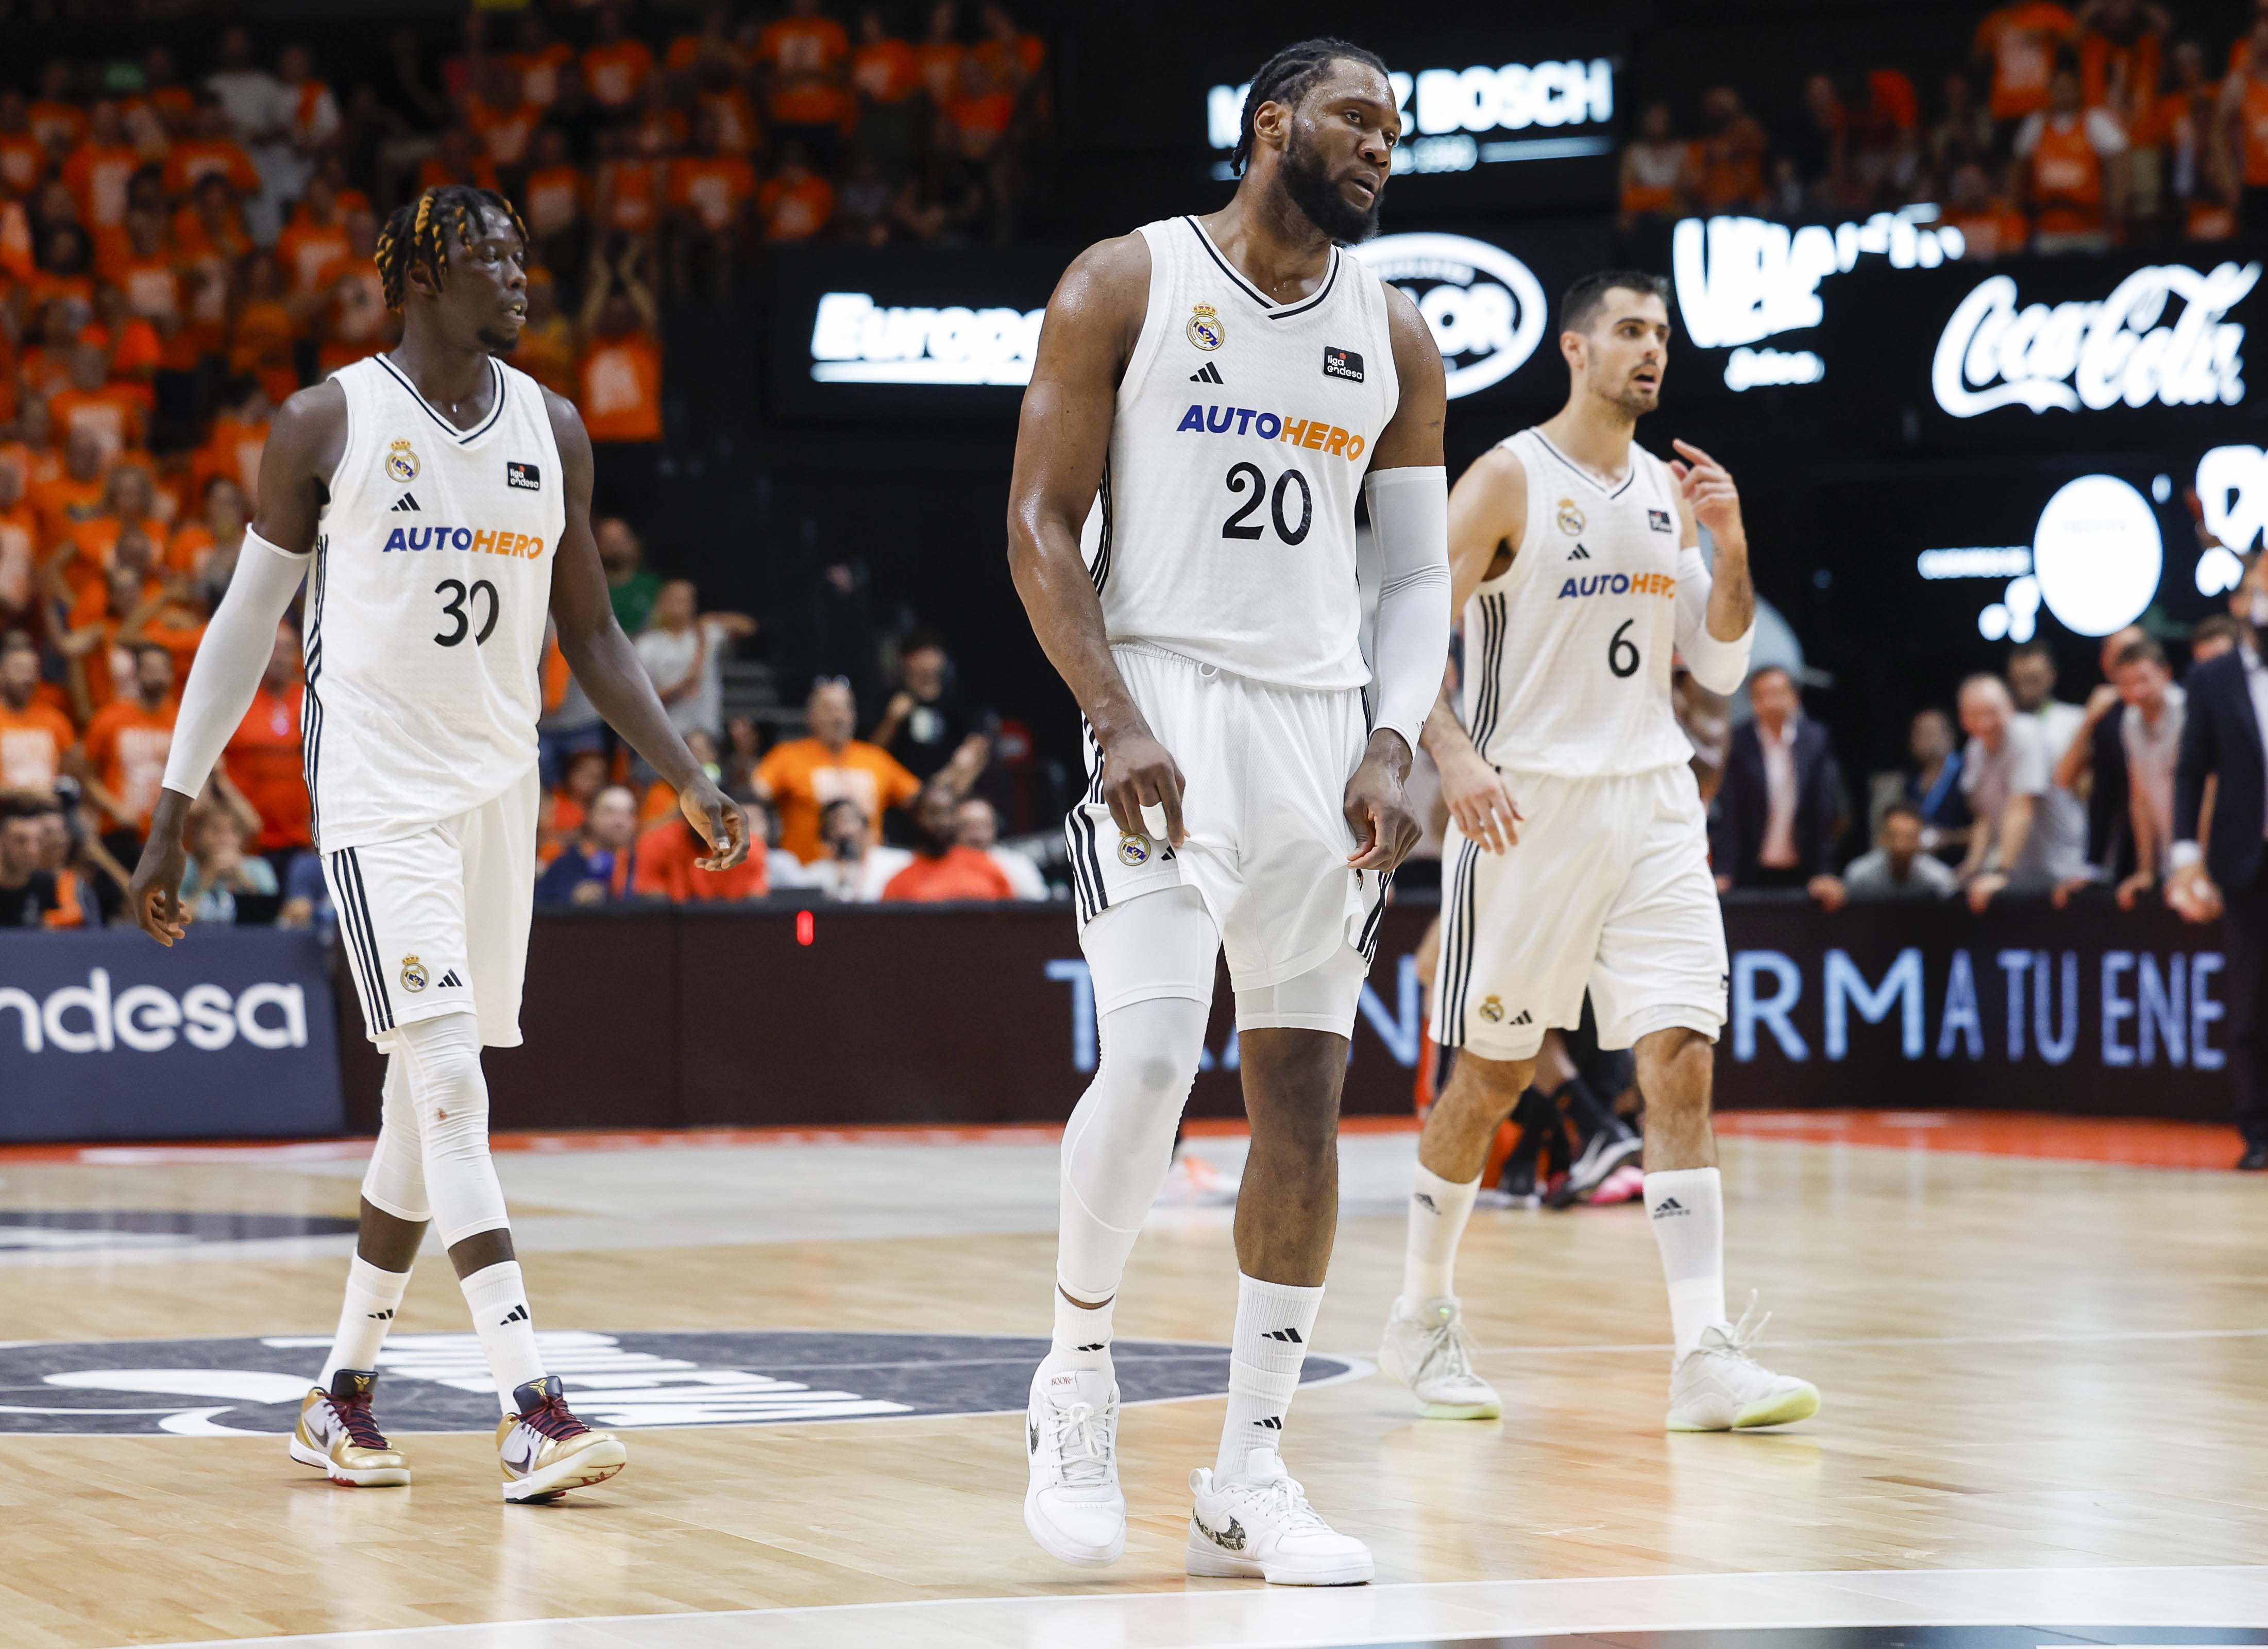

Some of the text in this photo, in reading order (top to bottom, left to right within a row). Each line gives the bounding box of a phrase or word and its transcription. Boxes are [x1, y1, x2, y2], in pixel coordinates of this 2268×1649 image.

[1416, 57, 1613, 135] BOSCH
[1327, 354, 1344, 367] liga
[1327, 365, 1362, 380] endesa
[1176, 405, 1365, 462] AUTOHERO
[510, 468, 523, 478] liga
[511, 478, 539, 488] endesa
[1222, 462, 1312, 546] 20
[383, 527, 544, 559] AUTOHERO
[433, 579, 500, 647] 30
[1609, 619, 1639, 677] 6
[1997, 949, 2078, 1065] TU
